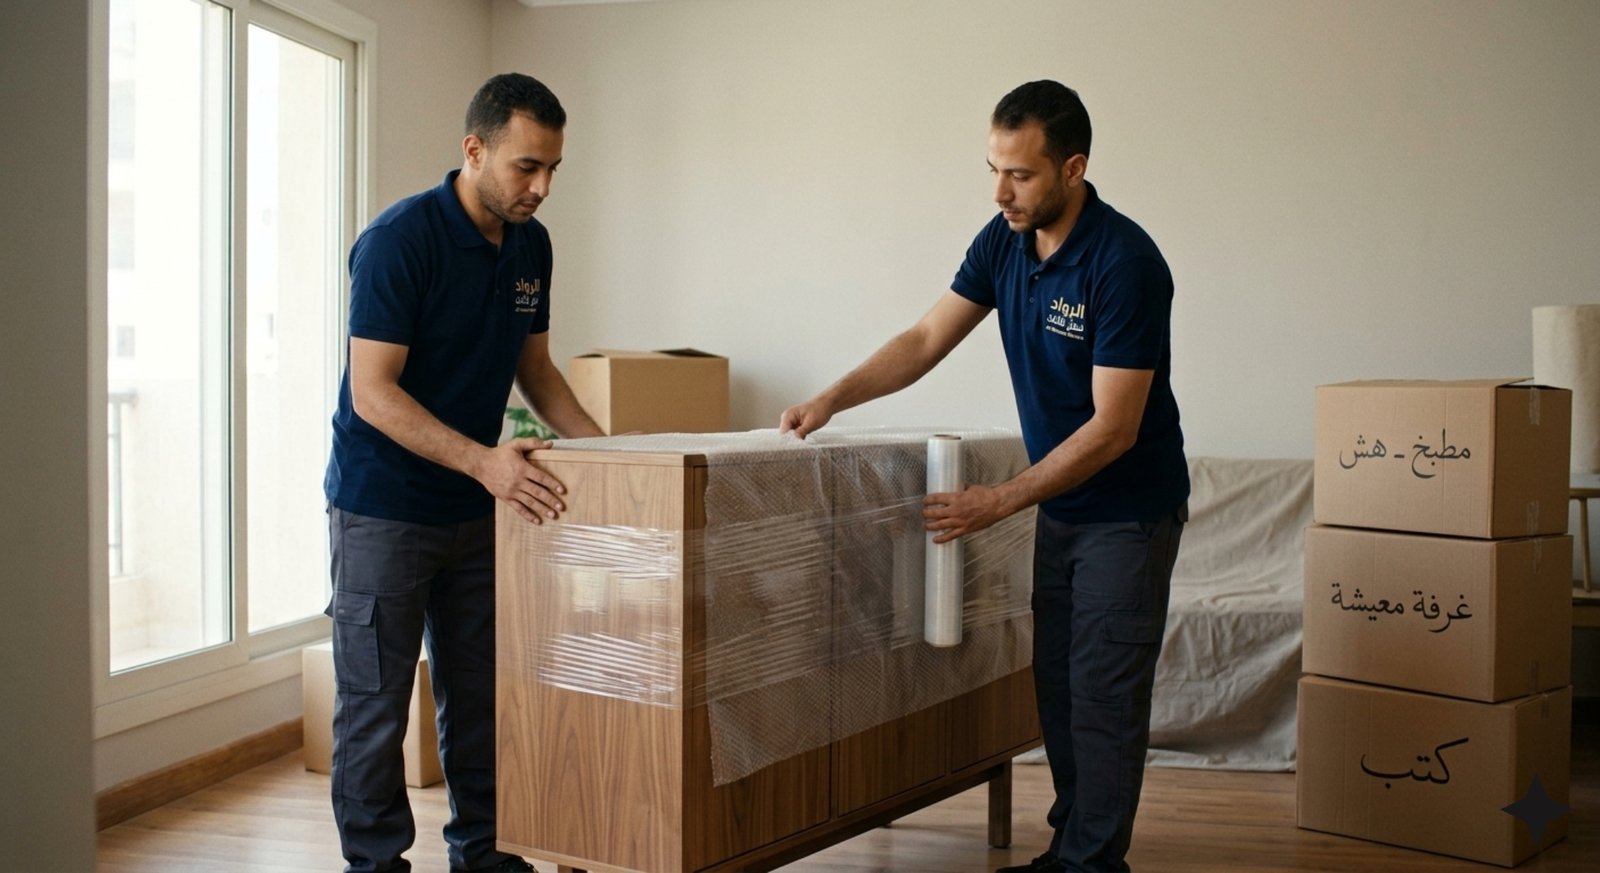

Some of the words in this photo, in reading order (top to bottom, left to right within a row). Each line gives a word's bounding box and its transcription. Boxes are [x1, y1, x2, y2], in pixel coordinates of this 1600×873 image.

[515, 277, 541, 295] الرواد
[1050, 296, 1085, 319] الرواد
[1339, 434, 1387, 470] هش
[1411, 428, 1471, 479] مطبخ
[1331, 582, 1405, 622] معيشة
[1412, 590, 1473, 633] غرفة
[1360, 737, 1469, 789] كتب
